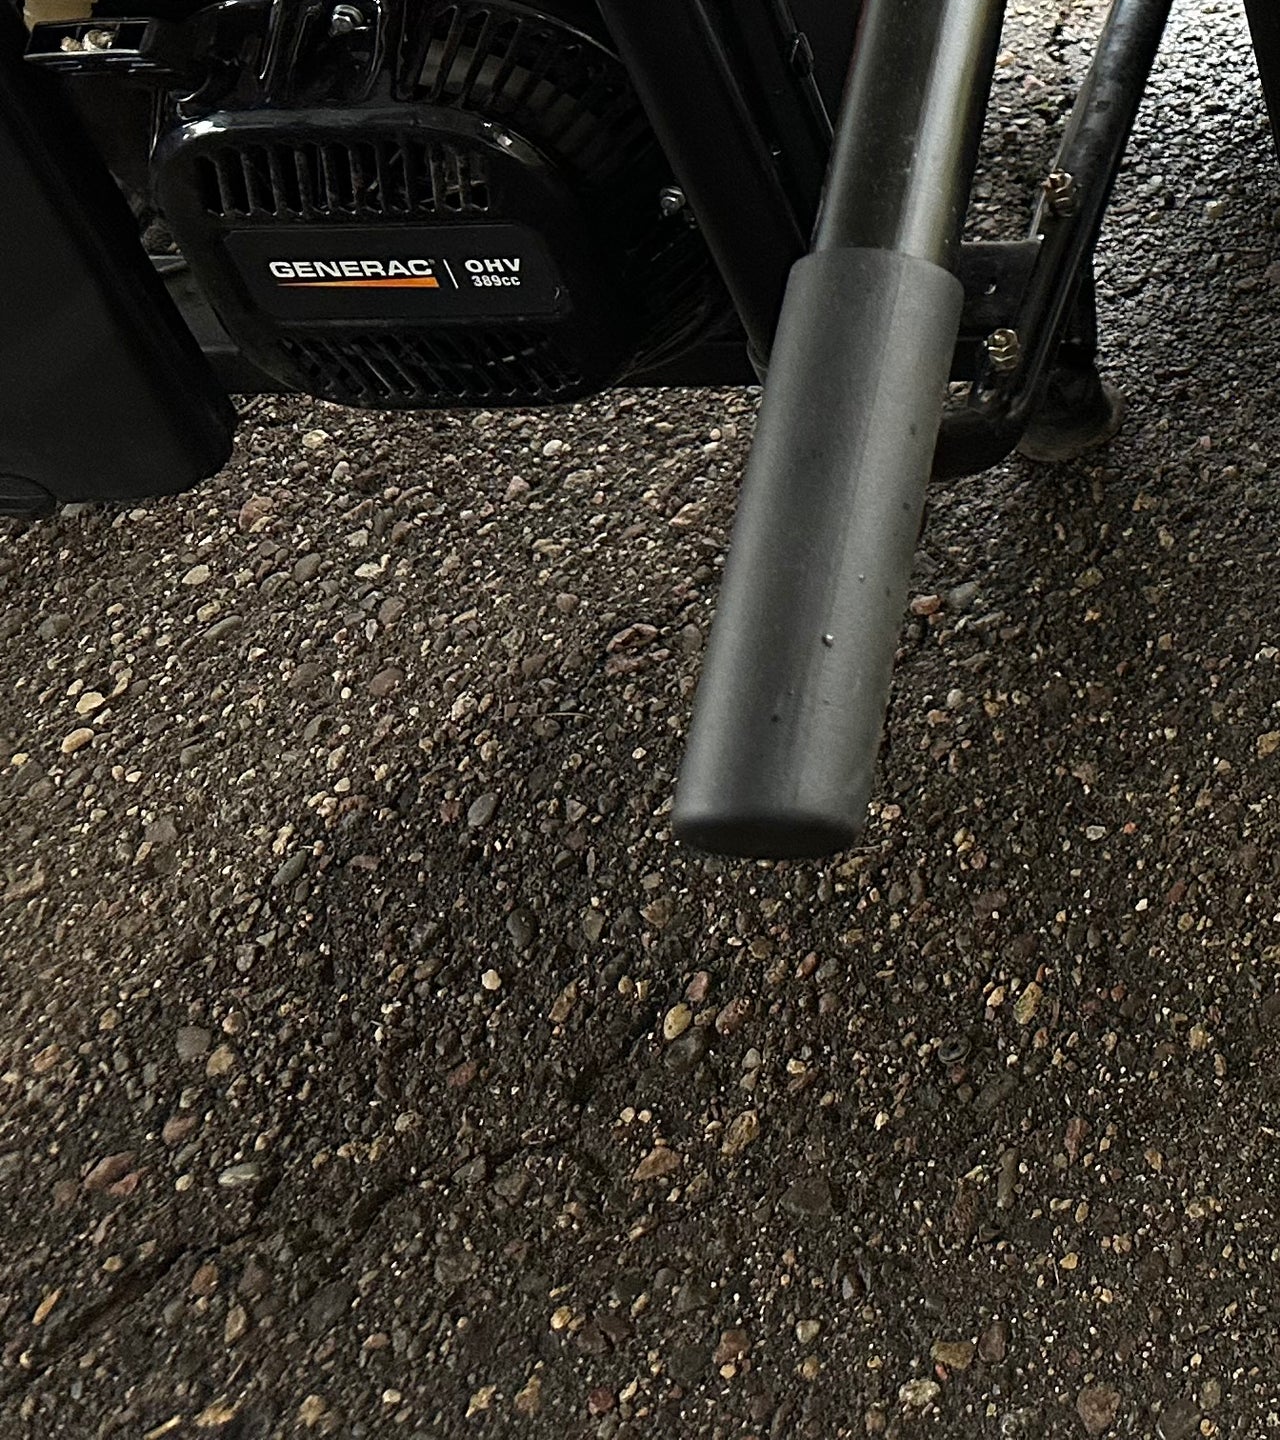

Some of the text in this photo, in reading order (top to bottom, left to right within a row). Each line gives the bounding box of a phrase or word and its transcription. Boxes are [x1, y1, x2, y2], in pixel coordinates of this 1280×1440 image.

[268, 258, 521, 279] GENERAC OHV
[471, 275, 521, 287] 389cc
